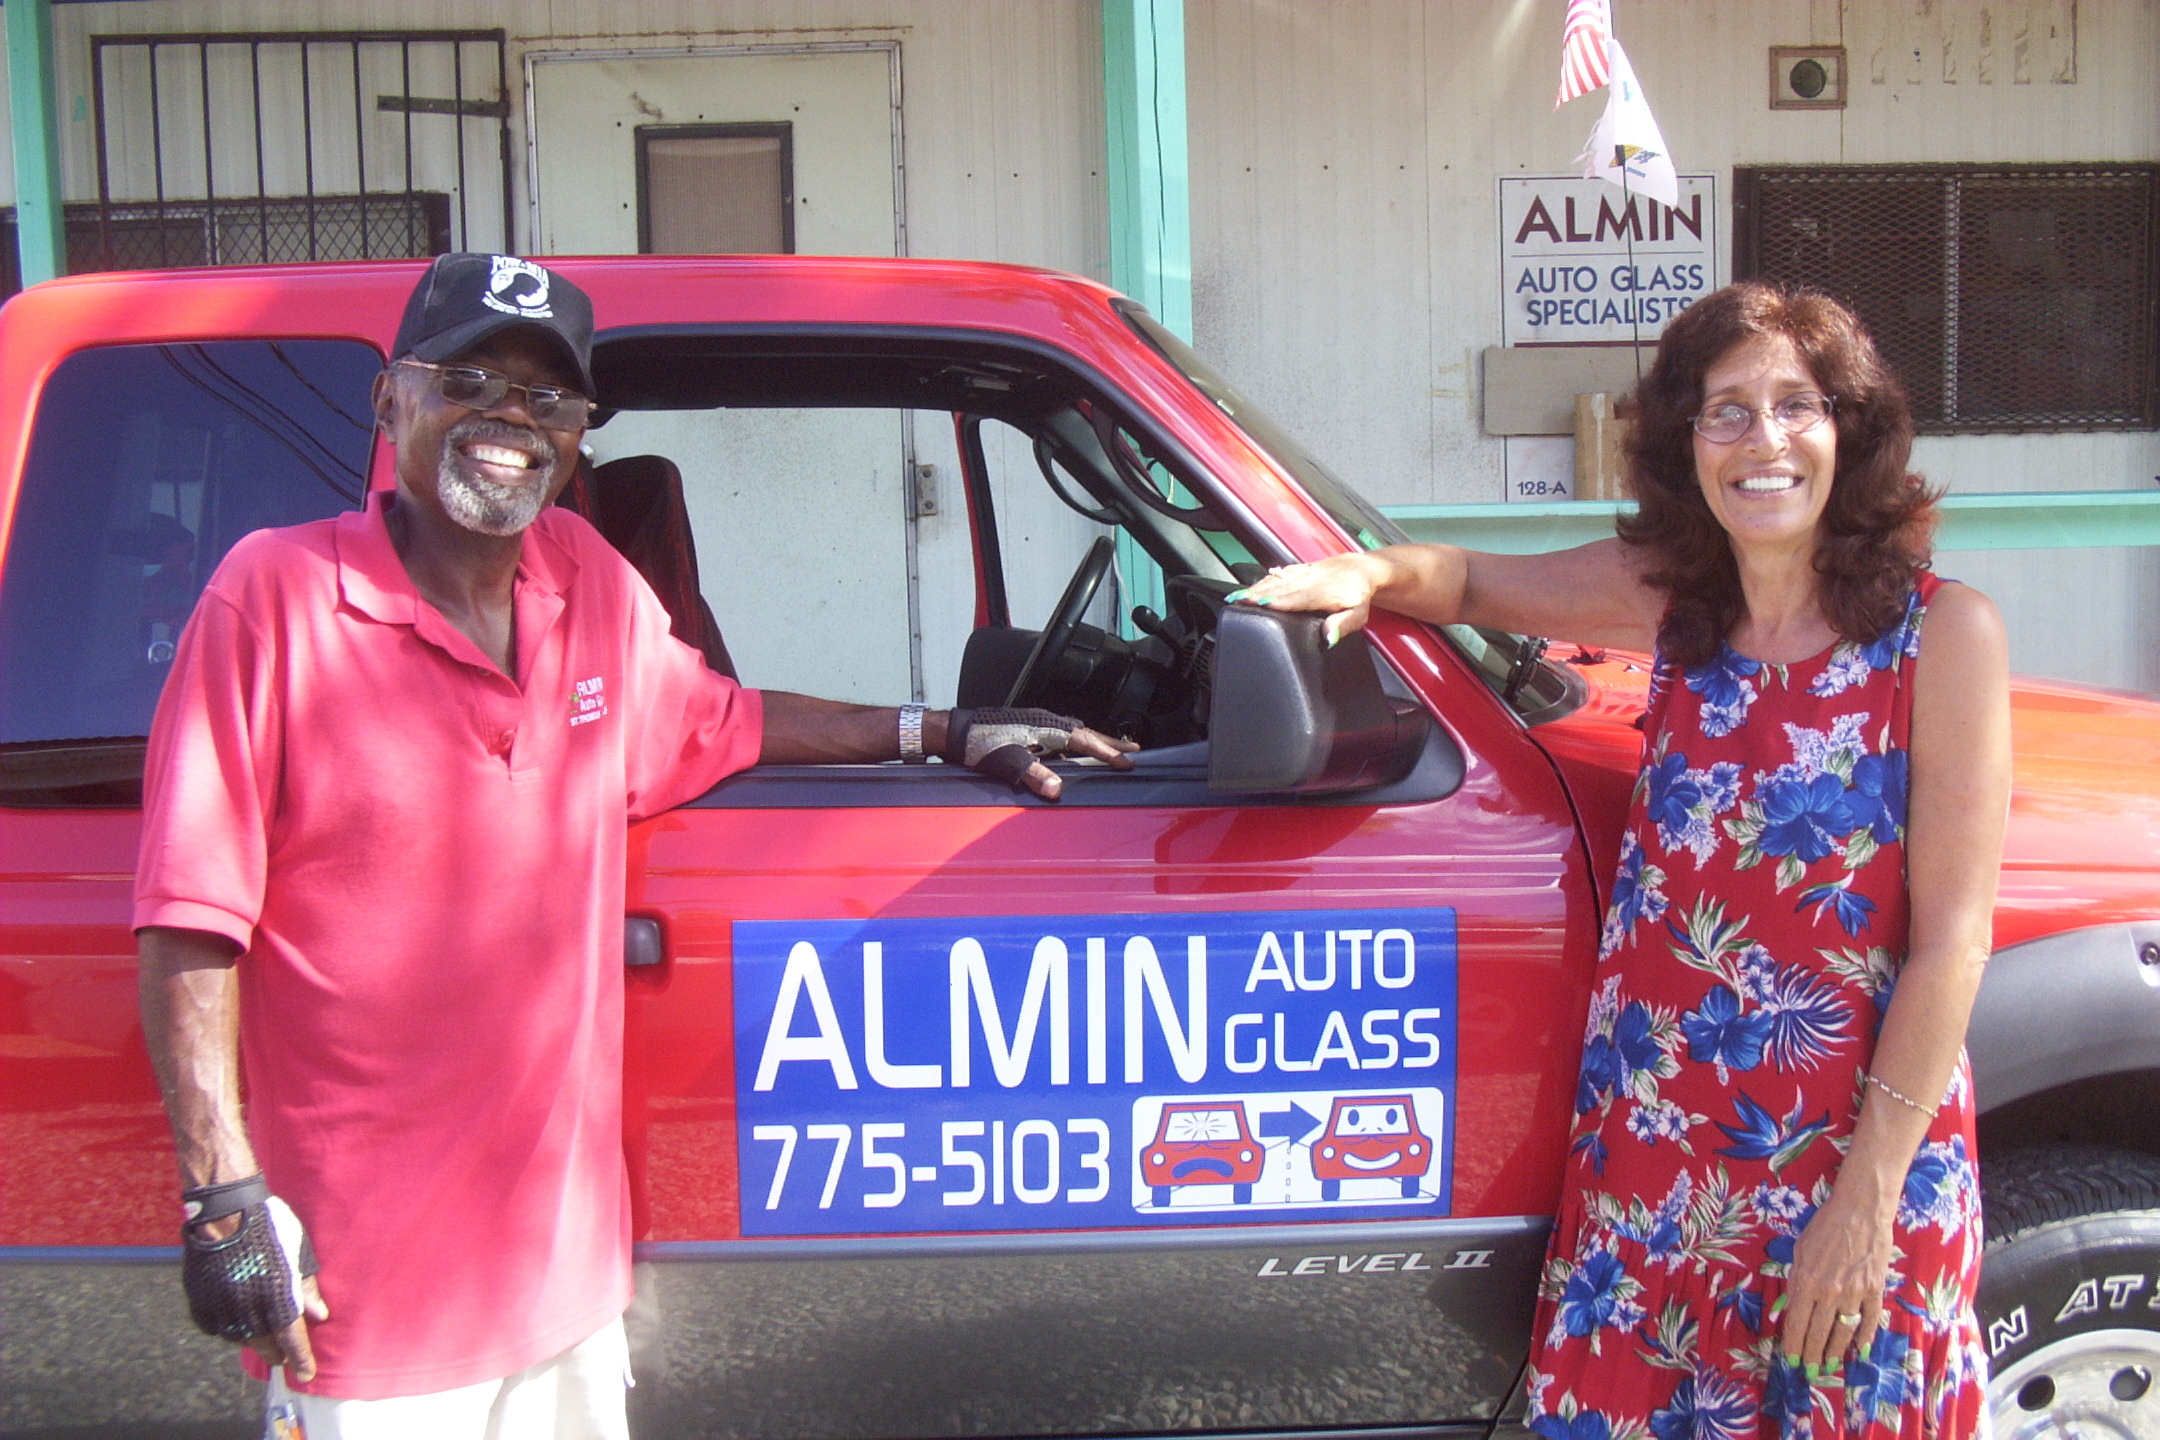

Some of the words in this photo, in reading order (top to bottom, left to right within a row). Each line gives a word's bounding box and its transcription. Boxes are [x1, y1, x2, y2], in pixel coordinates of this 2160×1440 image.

[1514, 193, 1702, 243] ALMIN
[1515, 266, 1598, 294] AUTO
[1610, 264, 1704, 292] GLASS
[1517, 480, 1567, 496] 128-A
[1244, 927, 1416, 993] AUTO
[753, 935, 1208, 1092] ALMIN
[1224, 1007, 1442, 1074] GLASS
[752, 1118, 1111, 1211] 775-5103
[1256, 1252, 1432, 1277] LEVEL
[1442, 1250, 1496, 1270] II
[2054, 1273, 2160, 1324] AT
